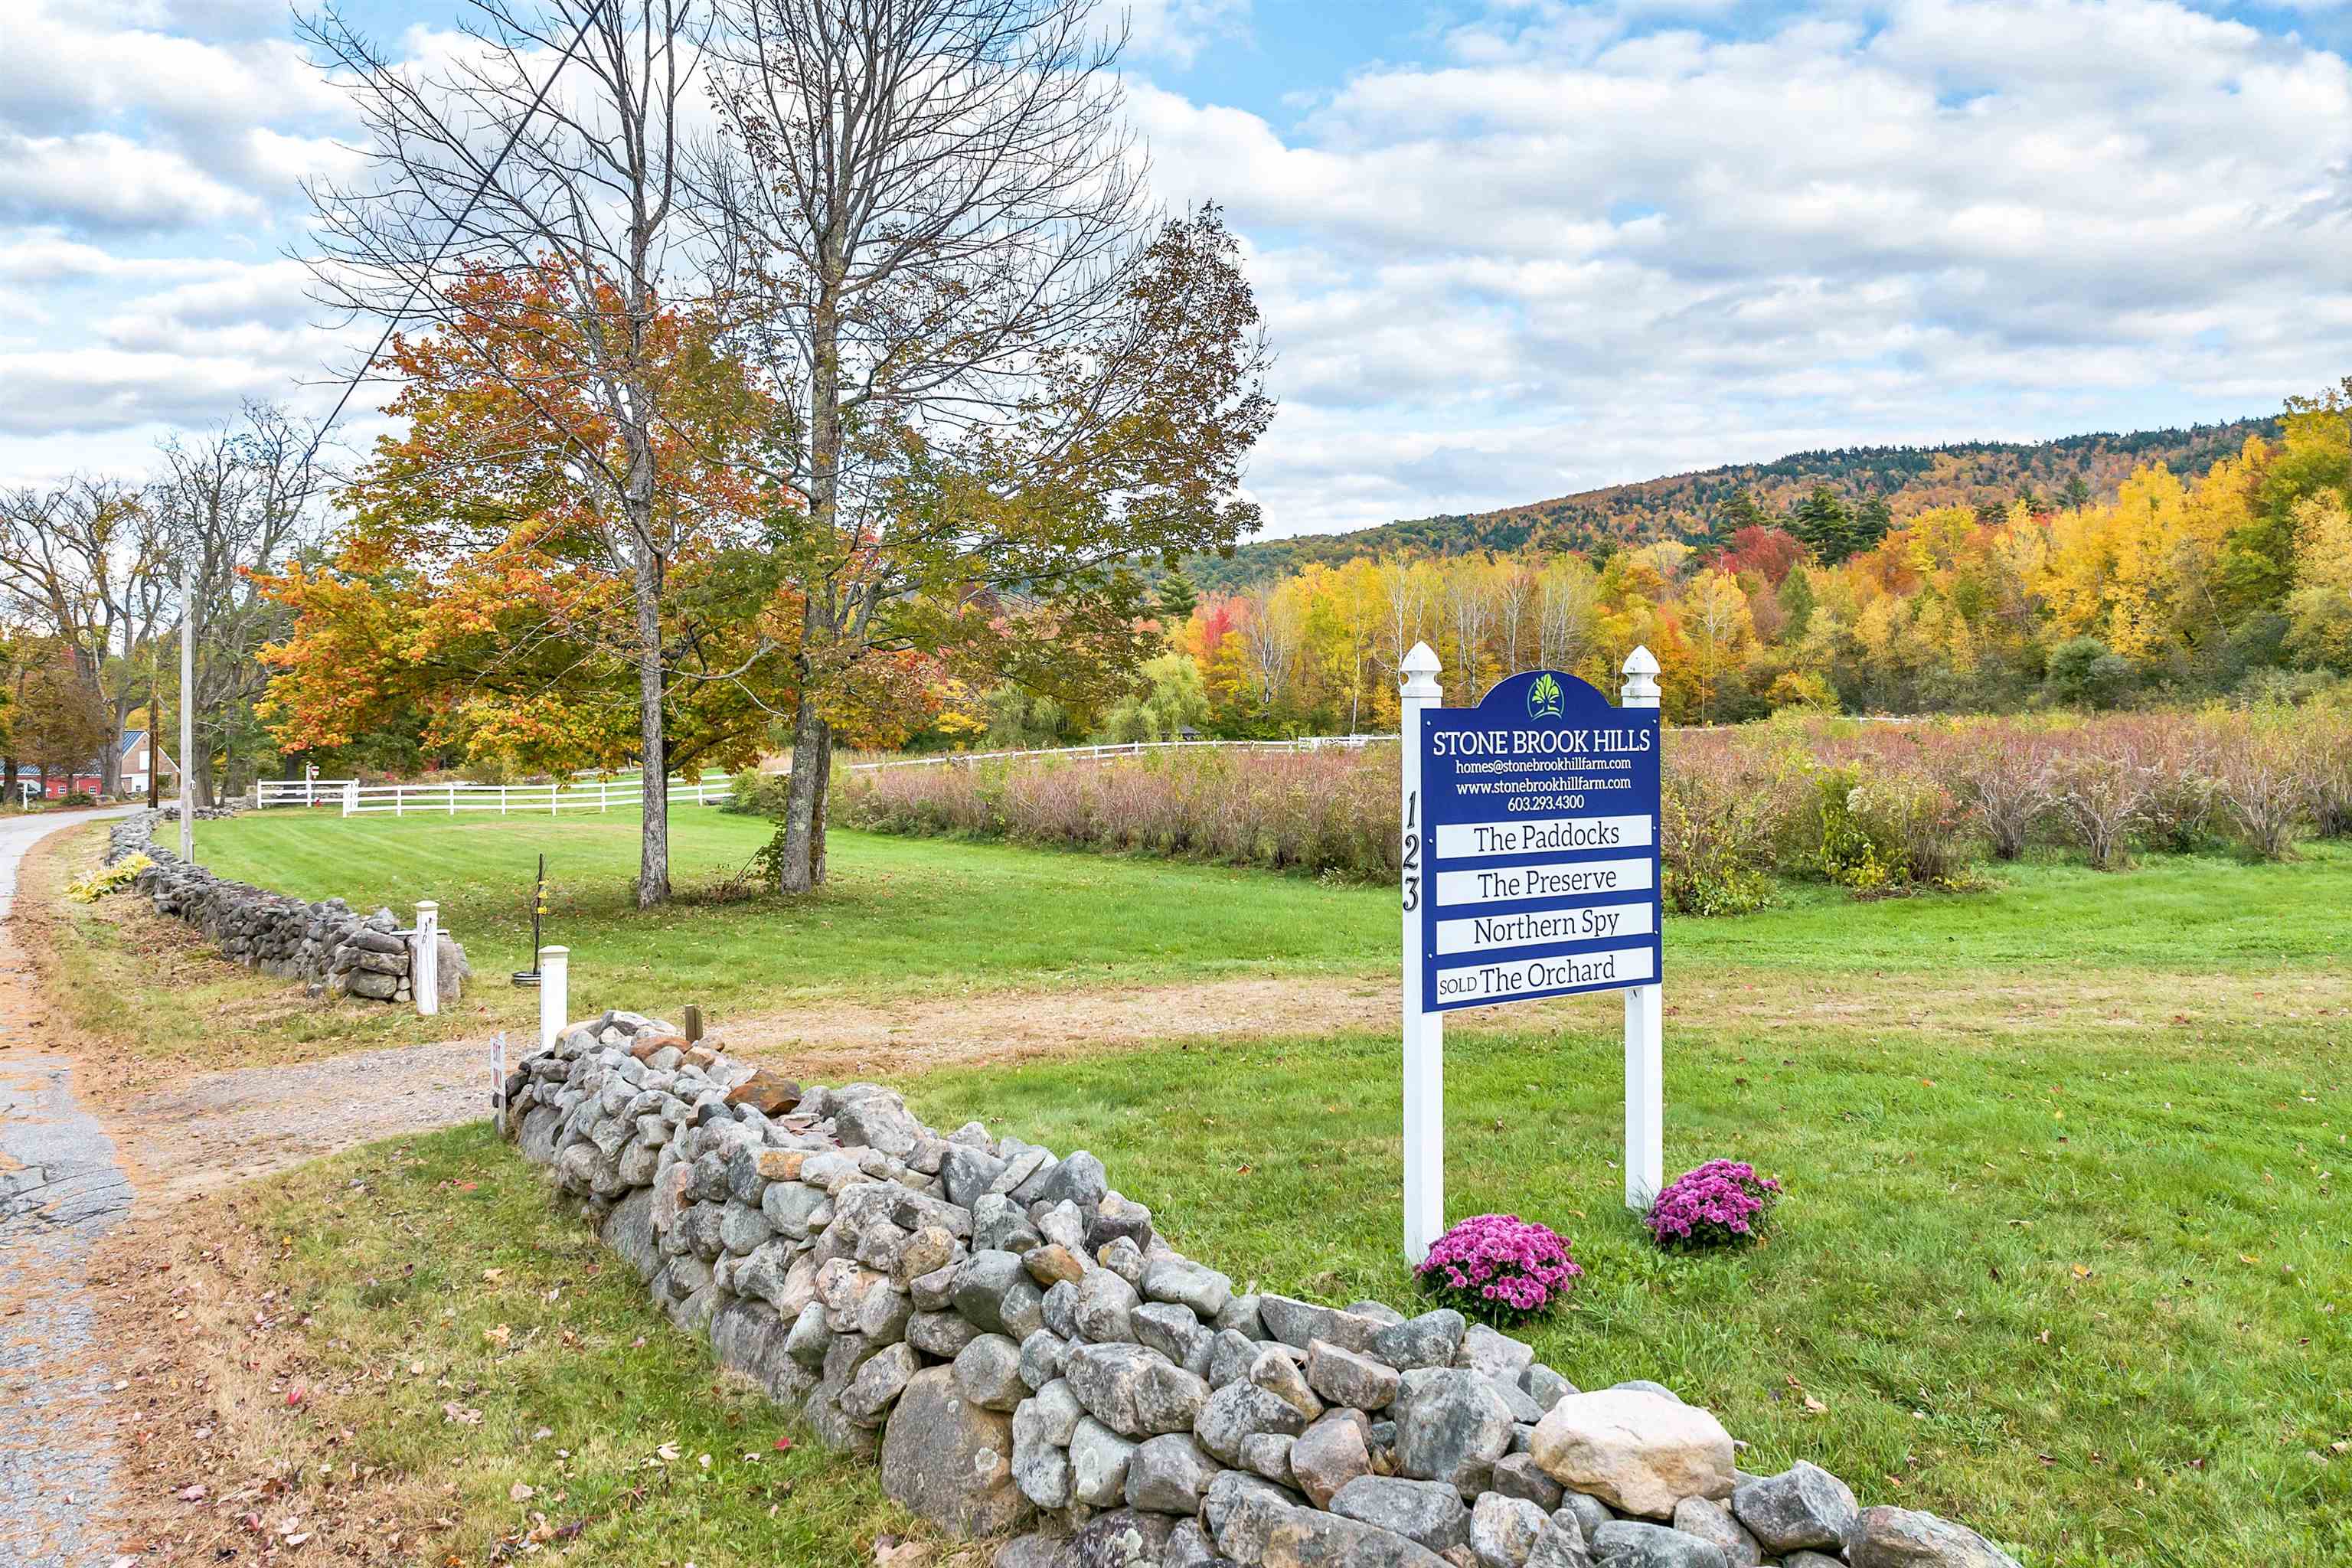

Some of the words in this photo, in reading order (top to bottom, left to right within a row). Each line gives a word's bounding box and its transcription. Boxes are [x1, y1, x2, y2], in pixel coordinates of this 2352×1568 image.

[1433, 730, 1508, 756] STONE
[1512, 730, 1589, 754] BROOK
[1592, 729, 1651, 752] HILLS
[1455, 756, 1632, 774] homes@stonebrookhillfarm.com
[1456, 776, 1632, 795] www.stonebrookhillfarm.com
[1508, 795, 1585, 812] 603.293.4300
[1474, 826, 1516, 852] The
[1522, 821, 1620, 849] Paddocks
[1478, 873, 1520, 899] The
[1526, 870, 1617, 895] Preserve
[1474, 914, 1576, 944] Northern
[1582, 909, 1620, 937] Spy
[1439, 976, 1478, 995] SOLD
[1480, 967, 1522, 994] The
[1527, 955, 1615, 988] Orchard
